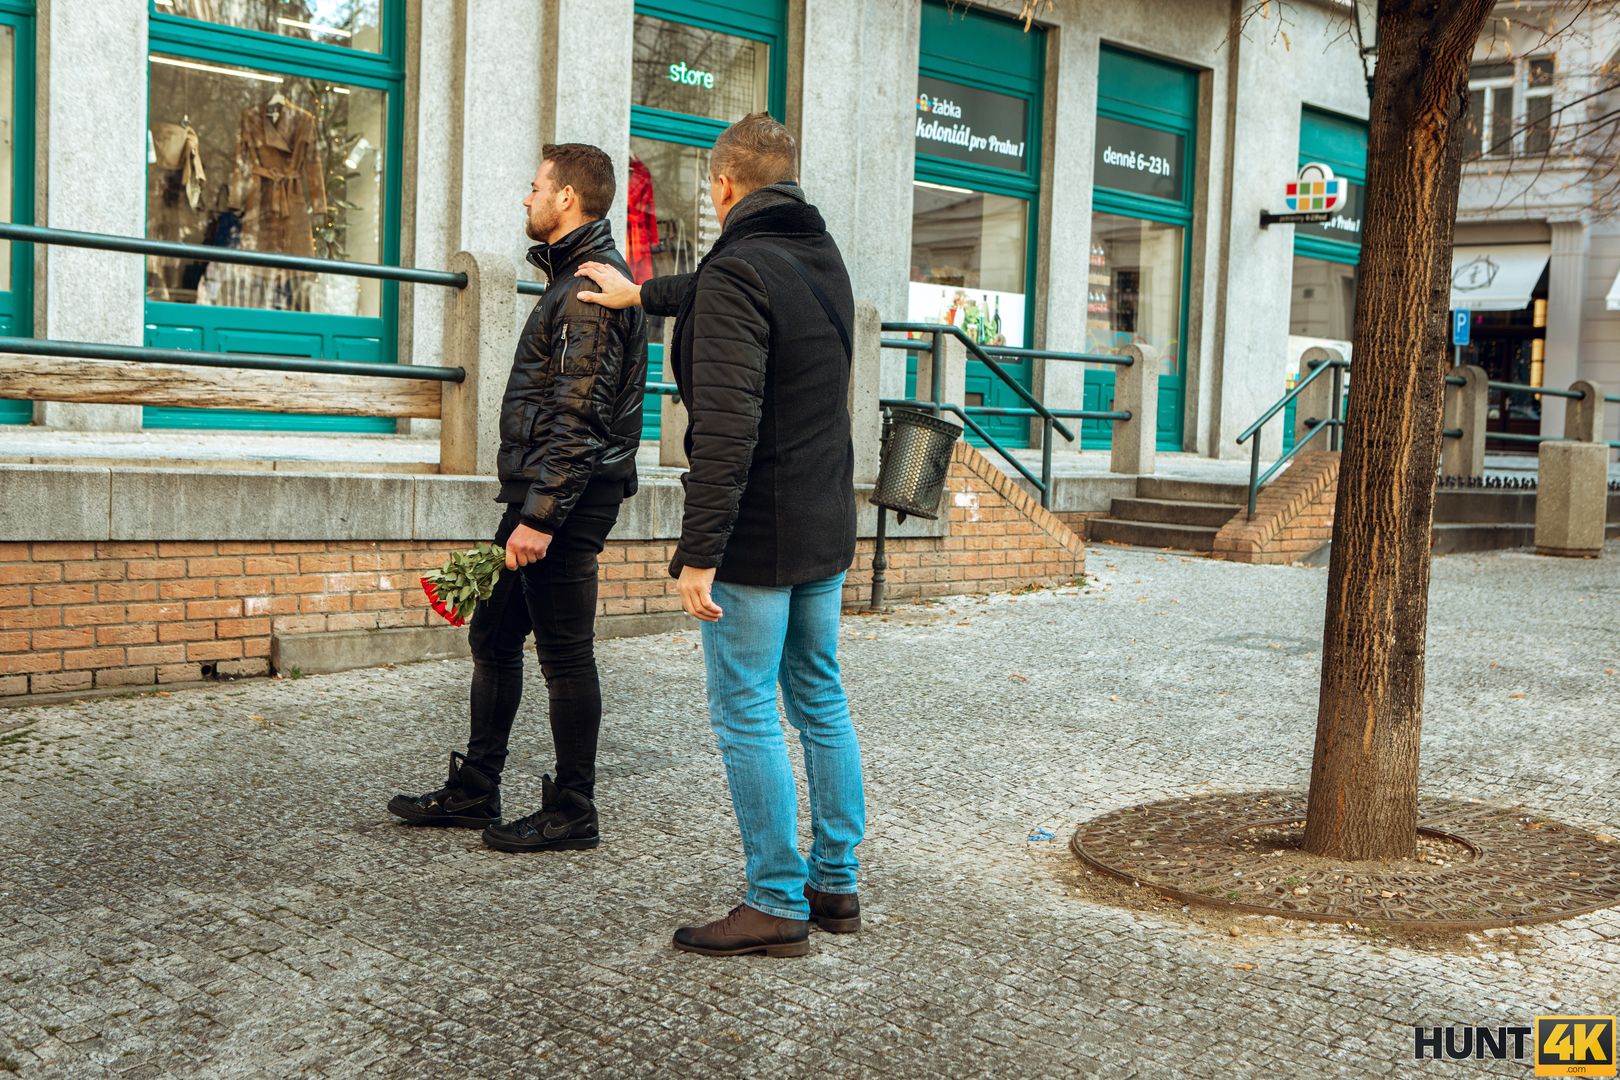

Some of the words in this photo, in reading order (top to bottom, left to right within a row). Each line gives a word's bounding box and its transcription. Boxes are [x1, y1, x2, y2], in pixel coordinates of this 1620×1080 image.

[669, 61, 714, 89] store
[932, 97, 961, 118] žabka
[916, 117, 970, 146] koloniál
[968, 135, 987, 151] pro
[988, 135, 1019, 156] Prahu
[1103, 146, 1136, 169] denně
[1162, 158, 1170, 176] h
[1457, 313, 1467, 333] P
